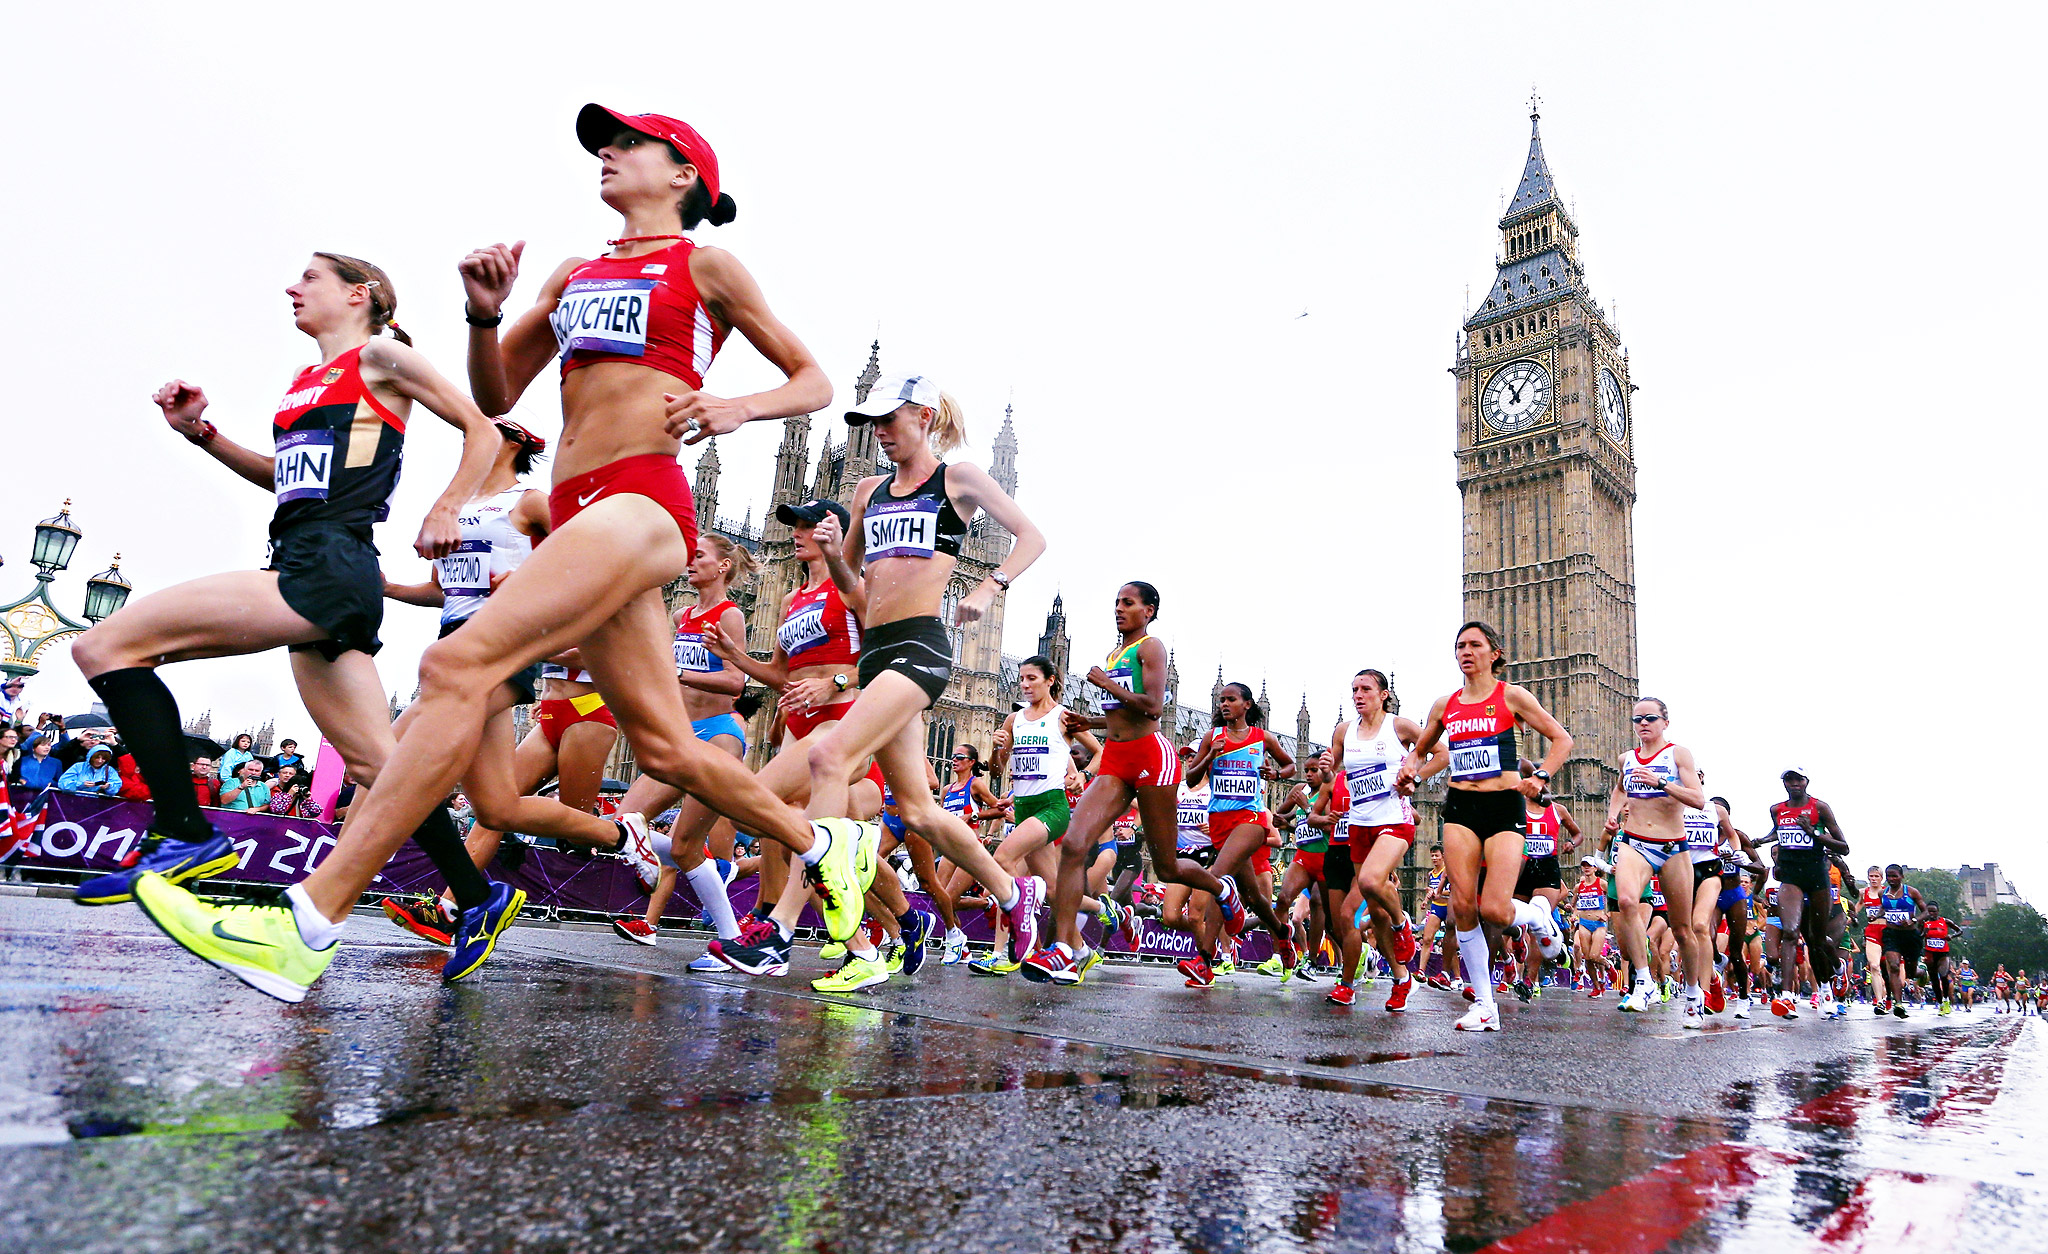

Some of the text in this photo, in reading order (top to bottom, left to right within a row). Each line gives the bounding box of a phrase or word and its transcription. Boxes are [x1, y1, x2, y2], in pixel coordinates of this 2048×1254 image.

[276, 451, 327, 487] AHN
[871, 517, 925, 548] SMITH
[1446, 717, 1497, 737] GERMANY
[1217, 759, 1253, 769] ERITREA
[1214, 778, 1256, 794] MEHARI
[1295, 826, 1322, 840] BABA
[1020, 877, 1035, 933] Reebok
[1139, 924, 1193, 953] London
